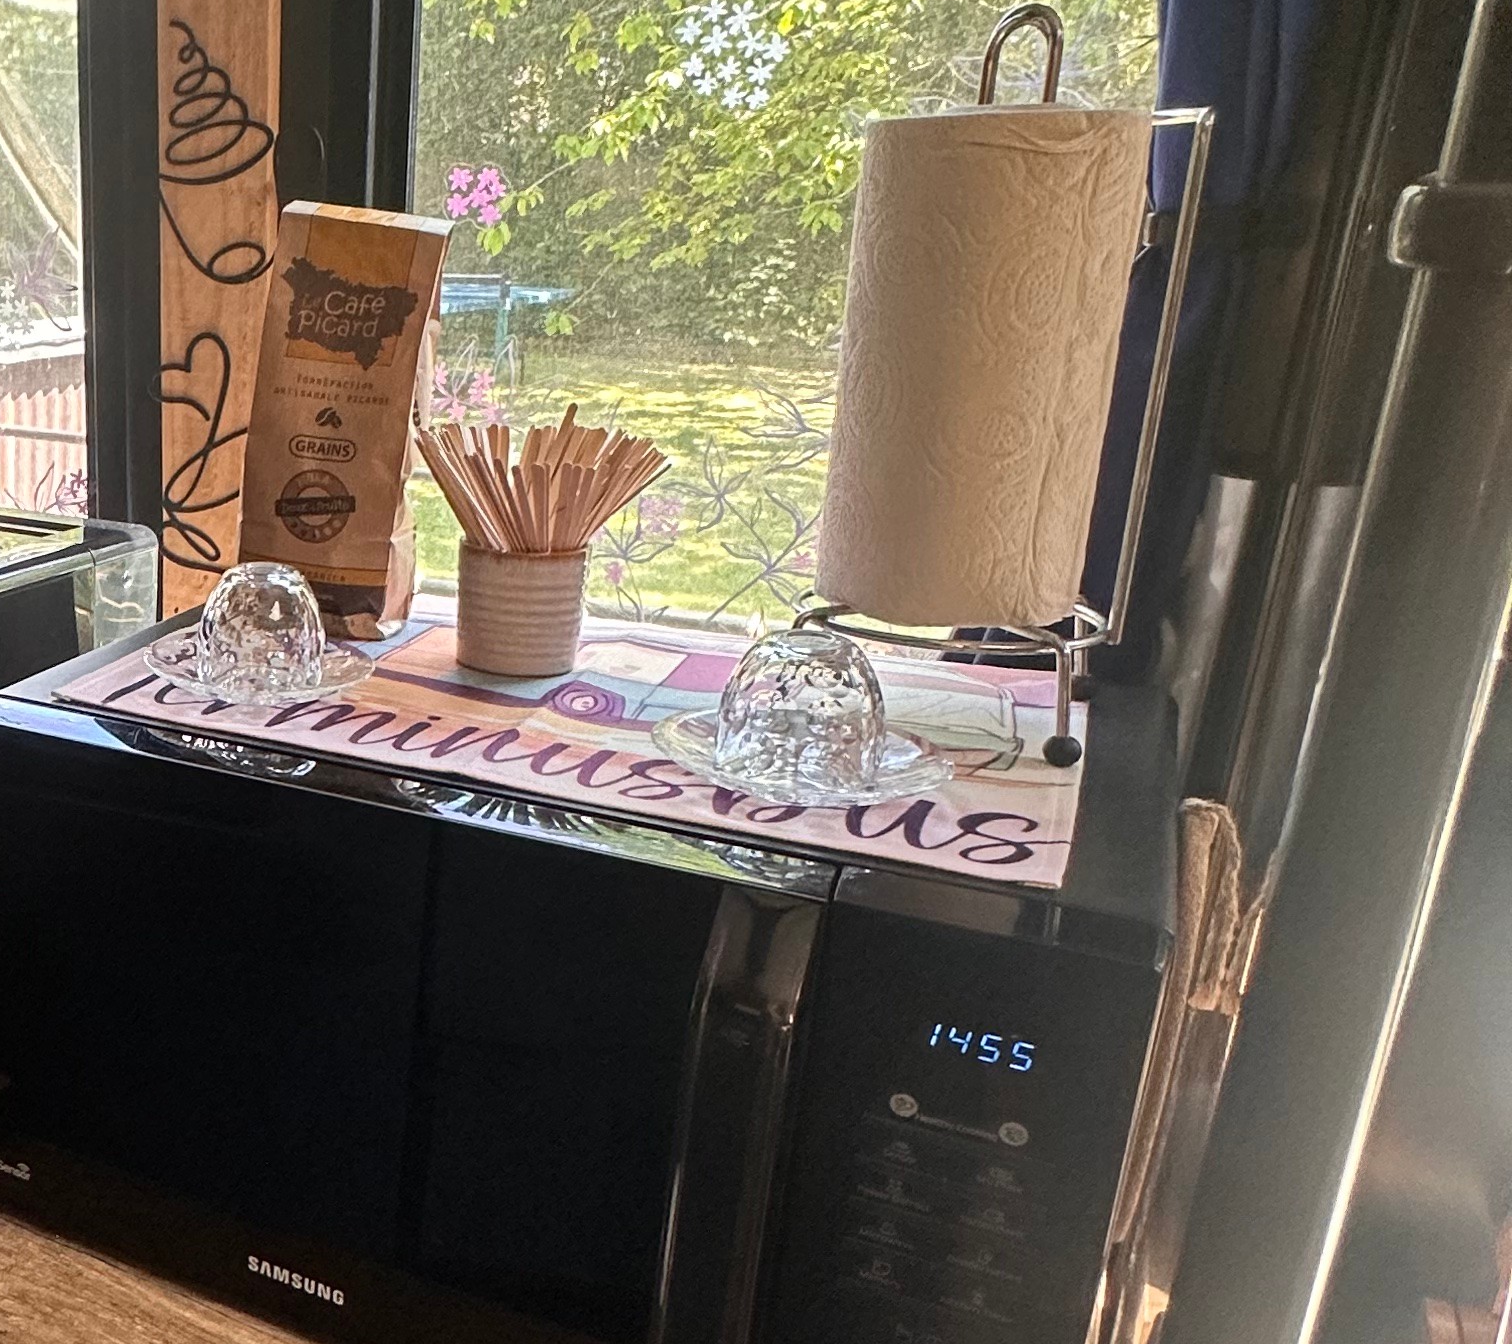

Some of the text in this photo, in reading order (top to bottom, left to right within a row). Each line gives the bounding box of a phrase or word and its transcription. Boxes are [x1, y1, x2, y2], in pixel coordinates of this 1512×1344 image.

[324, 290, 386, 316] Café
[295, 439, 351, 458] GRAINS
[929, 1023, 1036, 1072] 1455
[247, 1255, 345, 1306] SAMSUNG
